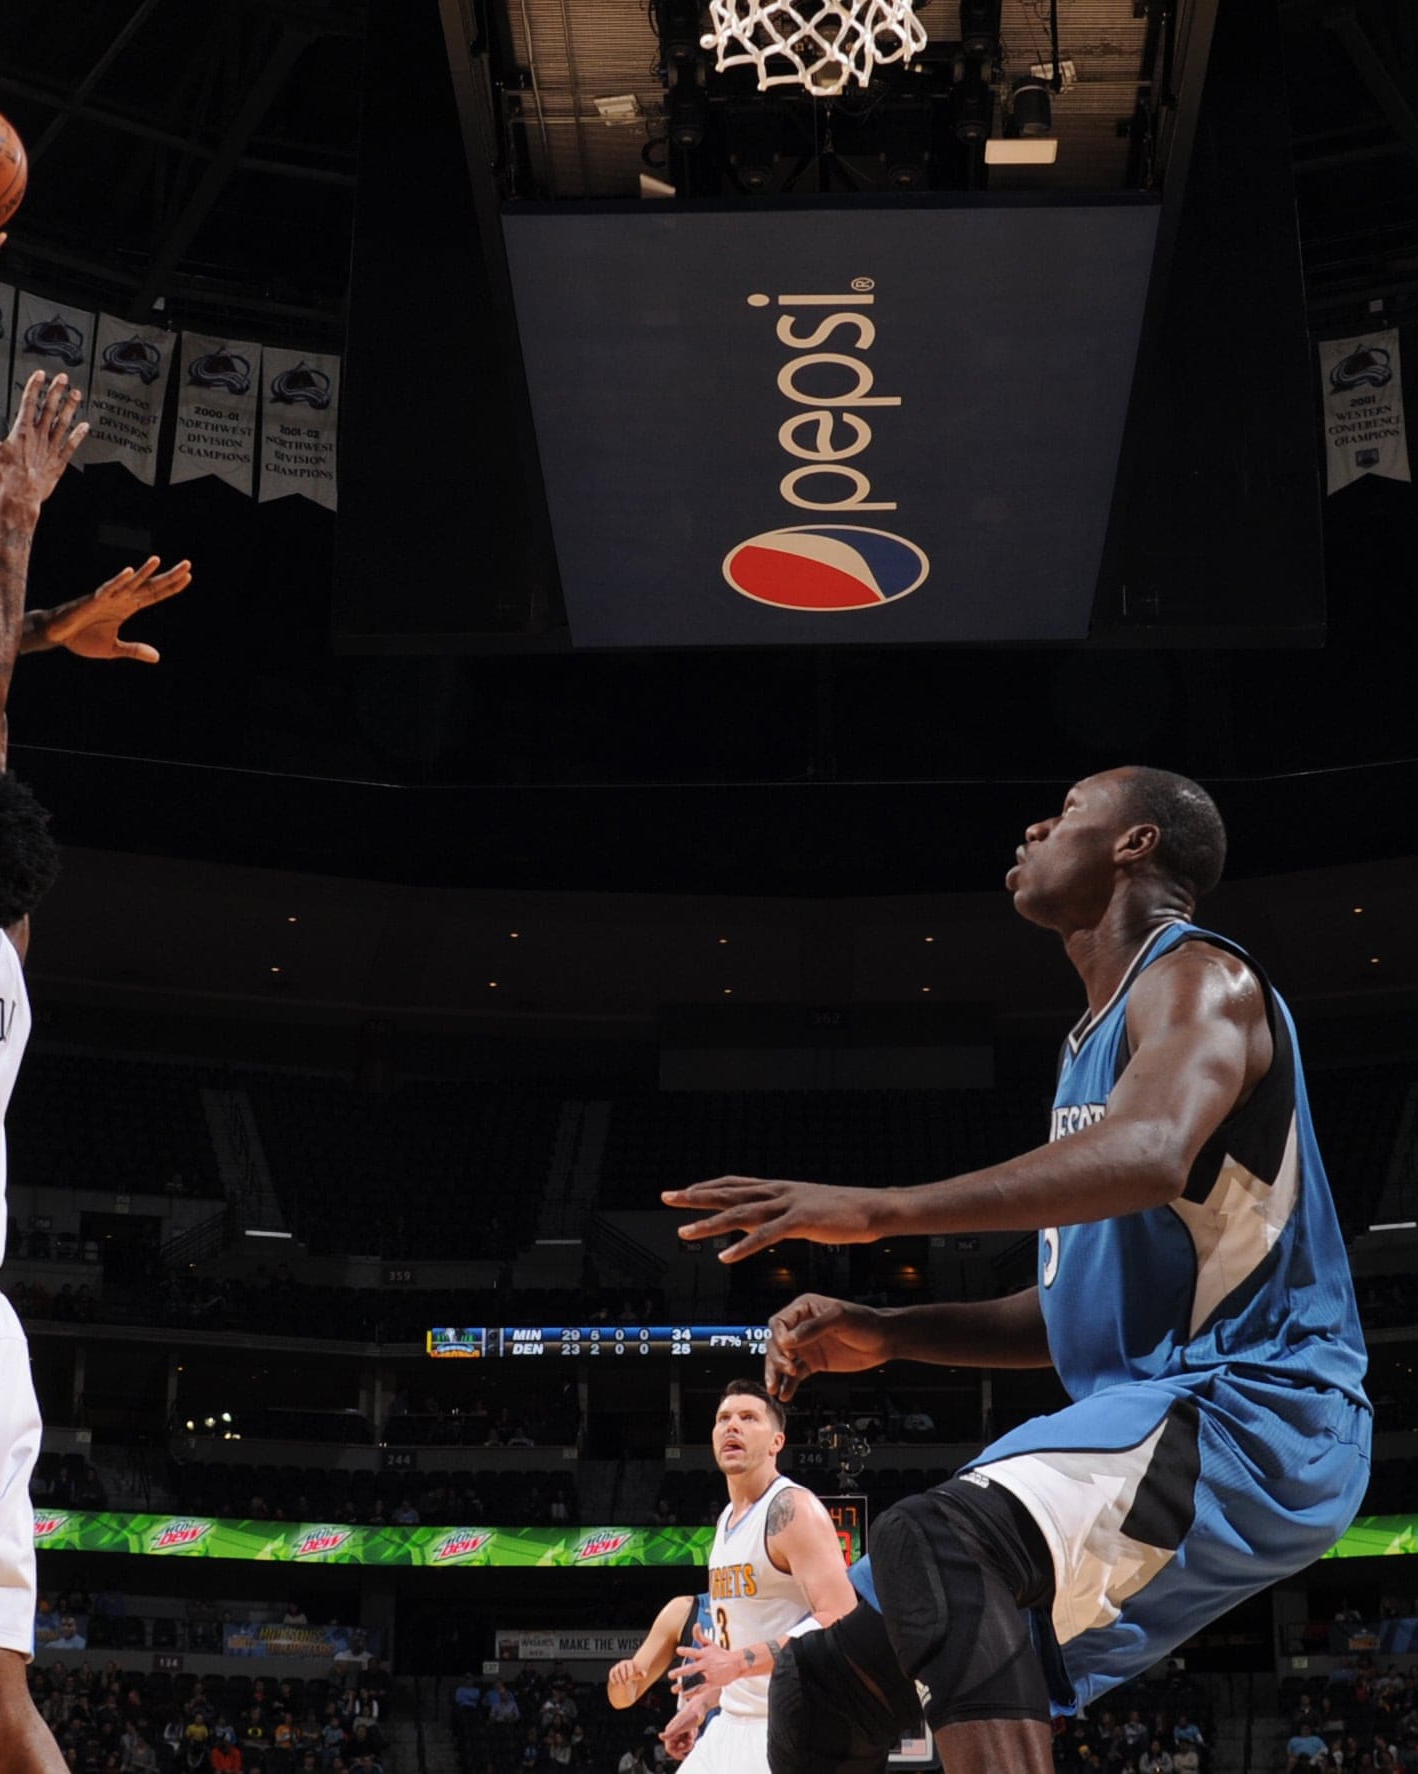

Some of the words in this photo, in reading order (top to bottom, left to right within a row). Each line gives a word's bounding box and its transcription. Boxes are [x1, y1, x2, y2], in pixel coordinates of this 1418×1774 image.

[746, 293, 902, 512] pepsi
[194, 406, 240, 422] 2000-01
[99, 415, 149, 439] DIVISION
[89, 428, 153, 454] CHAMPIONS
[187, 433, 243, 448] DIVISION
[1334, 429, 1399, 447] CHAMPIONS
[179, 445, 250, 463] CHAMPIONS
[275, 450, 326, 465] DIVISION
[265, 463, 333, 480] CHAMPIONS
[388, 1271, 412, 1281] 359
[512, 1330, 542, 1341] MIN
[561, 1330, 581, 1341] 29
[615, 1329, 624, 1341] 0
[639, 1329, 649, 1341] 0
[671, 1329, 692, 1341] 34
[709, 1335, 742, 1347] FT%
[745, 1328, 773, 1340] 100
[512, 1344, 543, 1355] DEN
[561, 1344, 581, 1355] 23
[589, 1344, 600, 1355] 2
[615, 1343, 624, 1355] 0
[639, 1343, 649, 1355] 0
[671, 1343, 691, 1355] 25
[386, 1456, 412, 1466] 244
[798, 1453, 825, 1464] 246
[717, 1607, 730, 1650] 3
[559, 1638, 591, 1650] MAKE
[595, 1638, 614, 1650] THE
